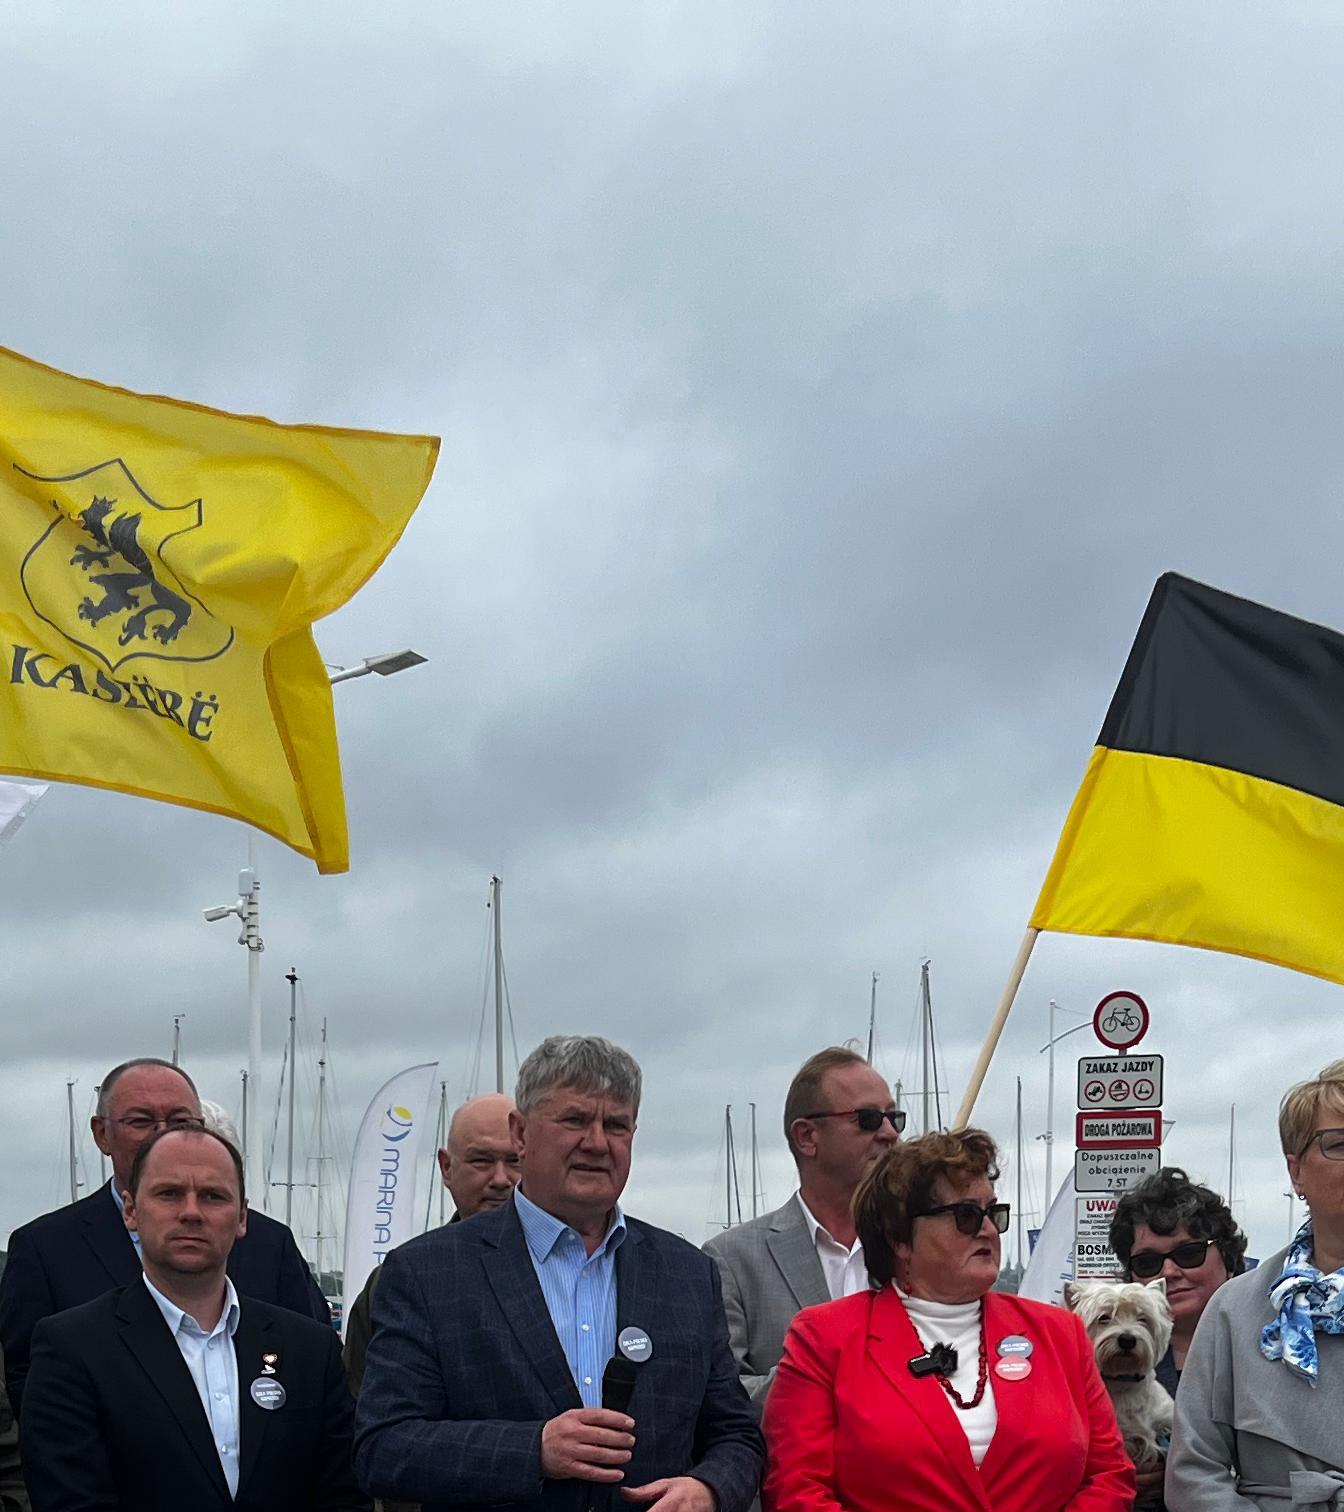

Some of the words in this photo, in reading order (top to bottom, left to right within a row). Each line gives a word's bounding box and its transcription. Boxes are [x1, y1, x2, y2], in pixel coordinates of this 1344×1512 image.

[1085, 1063, 1118, 1074] ZAKAZ
[1121, 1061, 1154, 1073] JAZDY
[1085, 1123, 1110, 1137] DROGA
[1111, 1121, 1153, 1137] POŻAROWA
[1081, 1151, 1154, 1162] Dopuszczalne
[1088, 1165, 1146, 1176] obciążenie
[373, 1148, 400, 1244] MARINA
[1086, 1200, 1119, 1212] UWA
